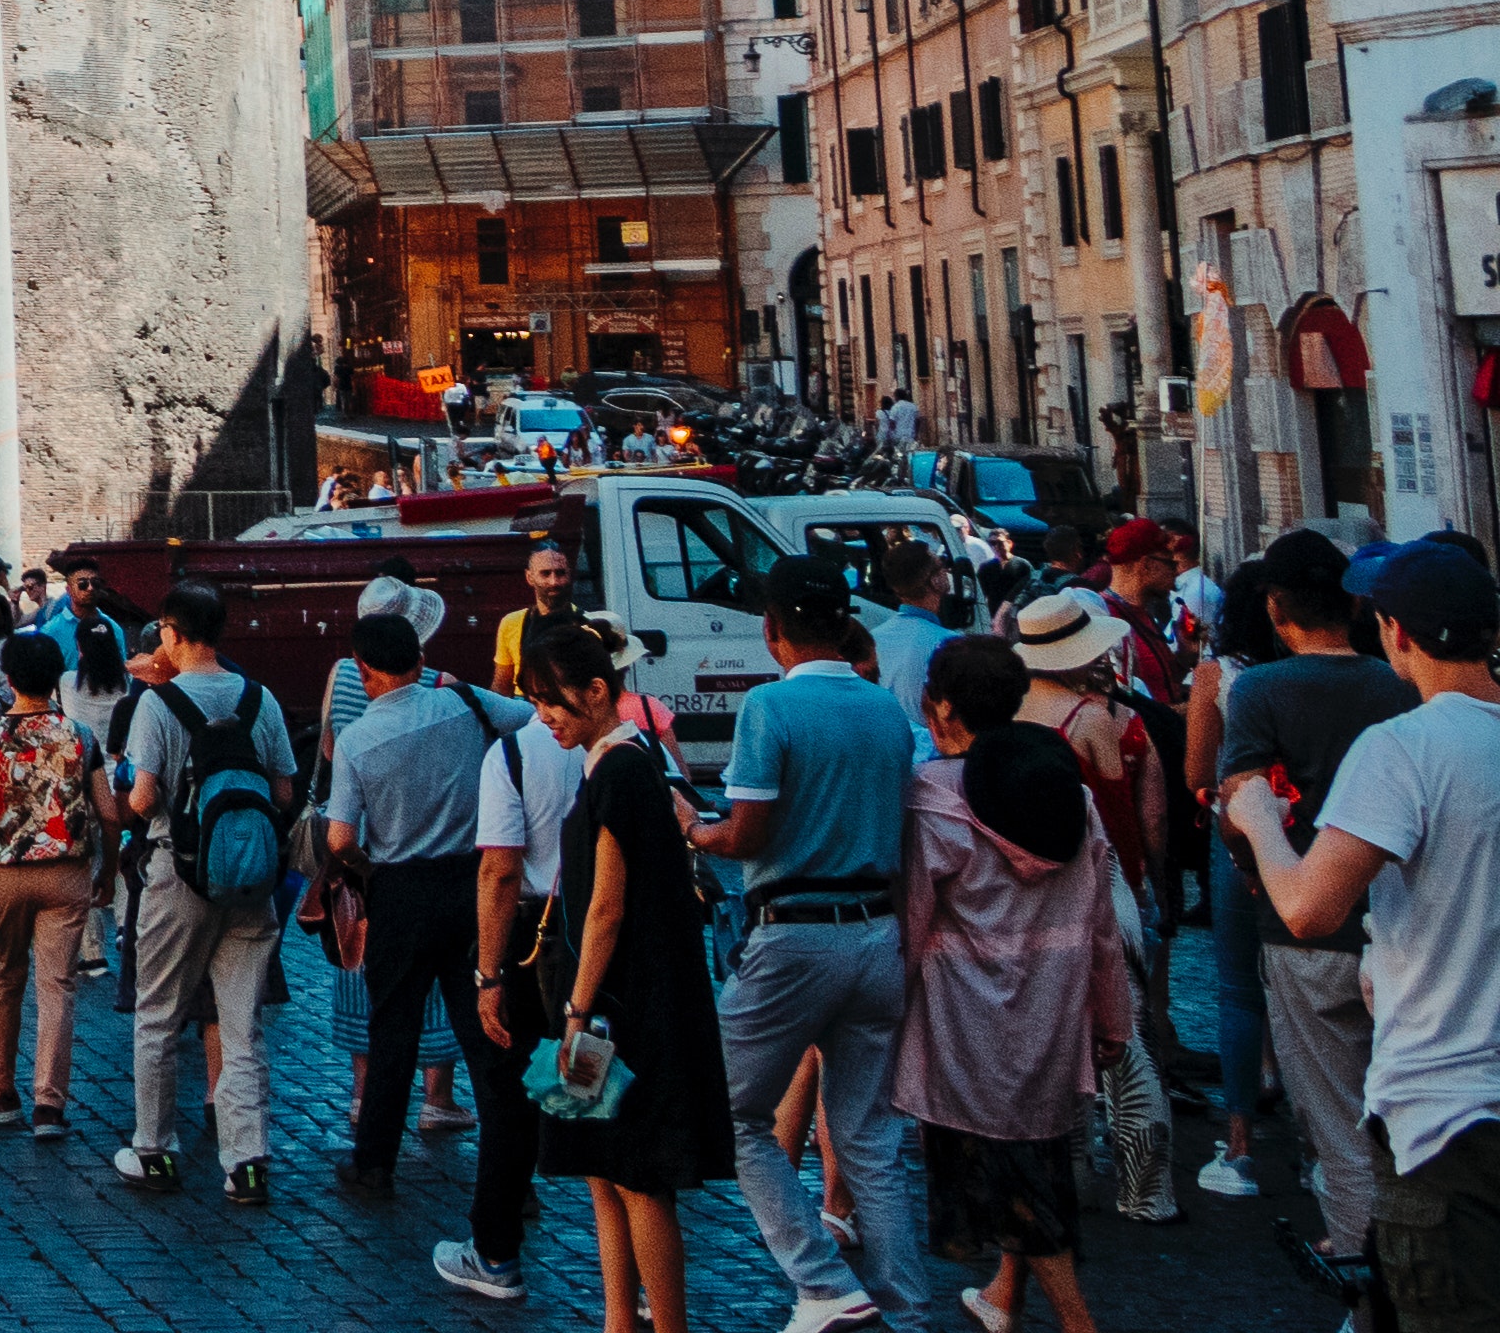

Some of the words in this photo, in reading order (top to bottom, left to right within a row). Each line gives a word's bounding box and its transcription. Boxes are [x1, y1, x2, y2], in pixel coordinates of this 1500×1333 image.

[421, 373, 454, 386] TAXI
[714, 658, 745, 669] ama
[643, 693, 729, 712] CR874
